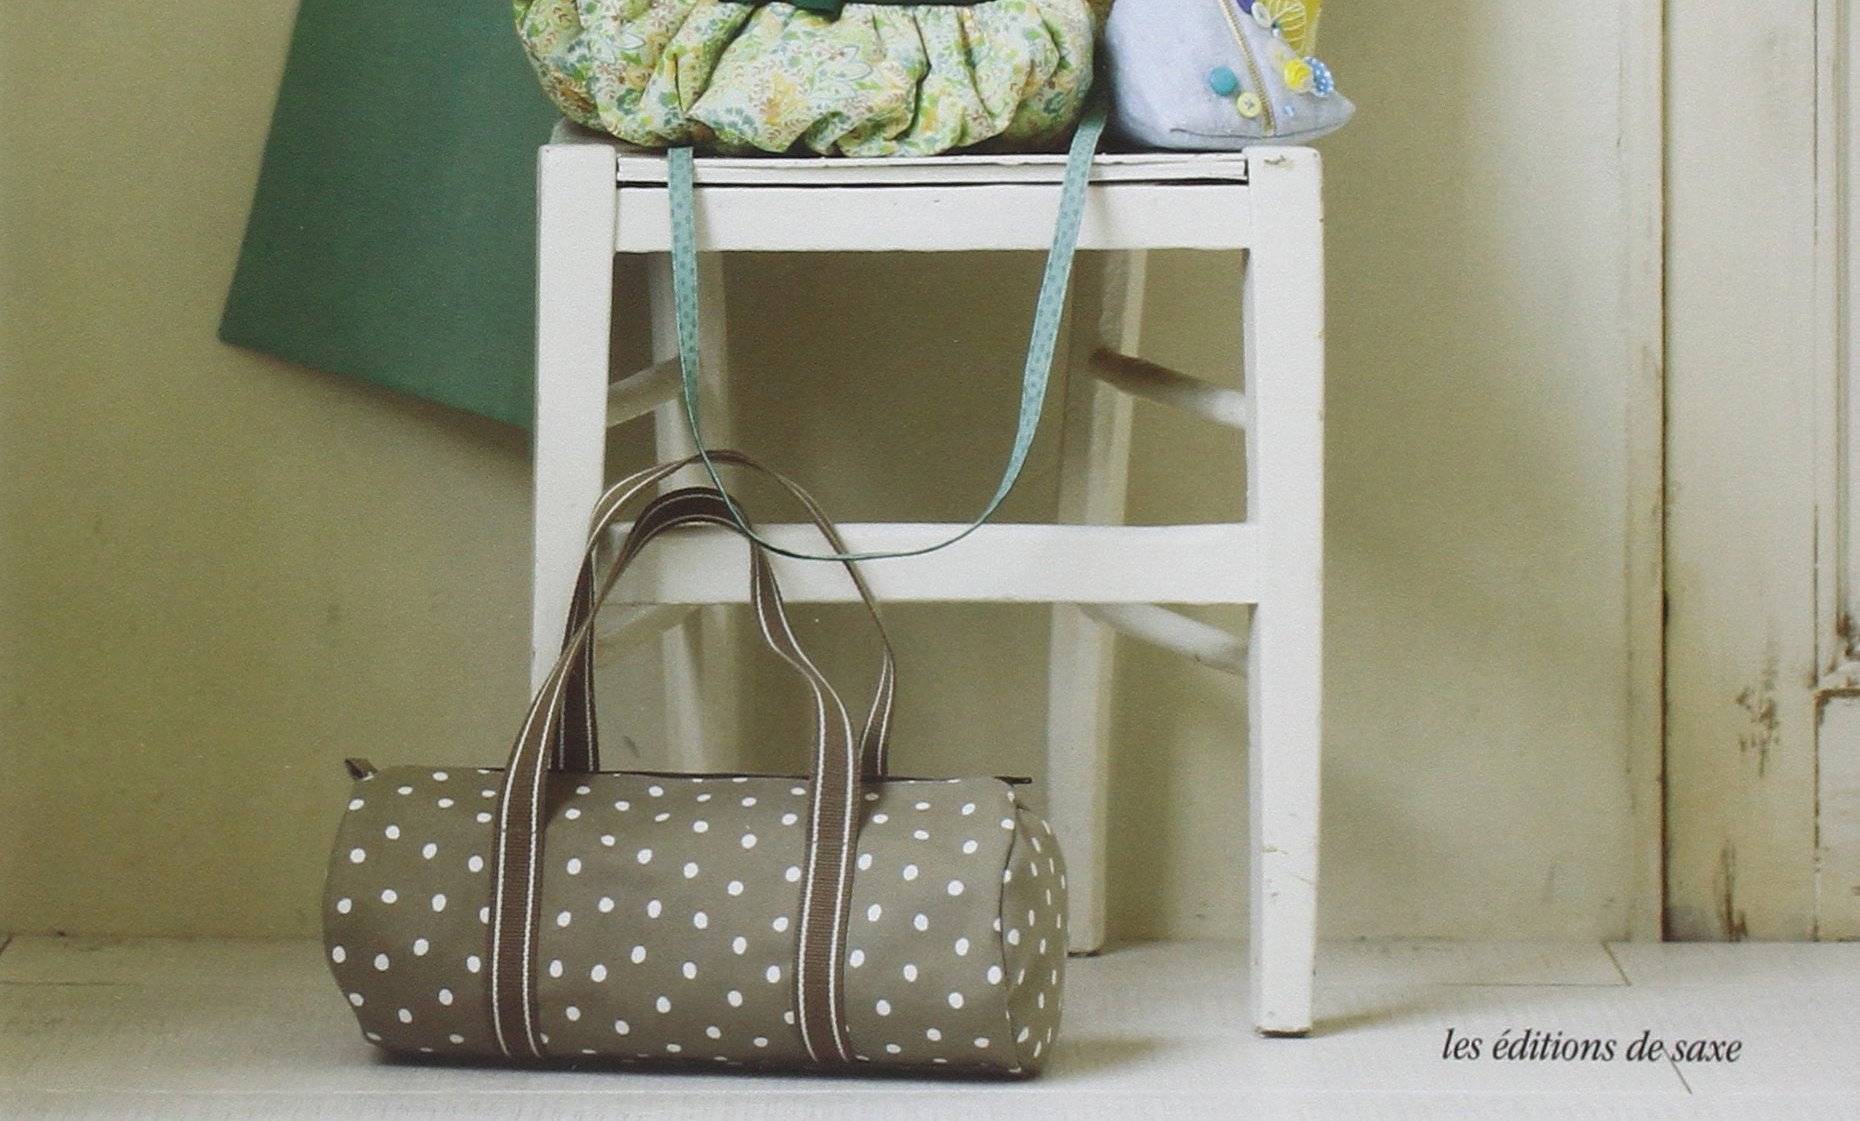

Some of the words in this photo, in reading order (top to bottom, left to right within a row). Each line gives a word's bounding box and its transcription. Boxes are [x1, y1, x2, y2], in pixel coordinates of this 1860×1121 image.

[1442, 1027, 1483, 1061] les
[1492, 1028, 1617, 1062] éditions
[1626, 1029, 1664, 1062] de
[1671, 1039, 1742, 1063] saxe
